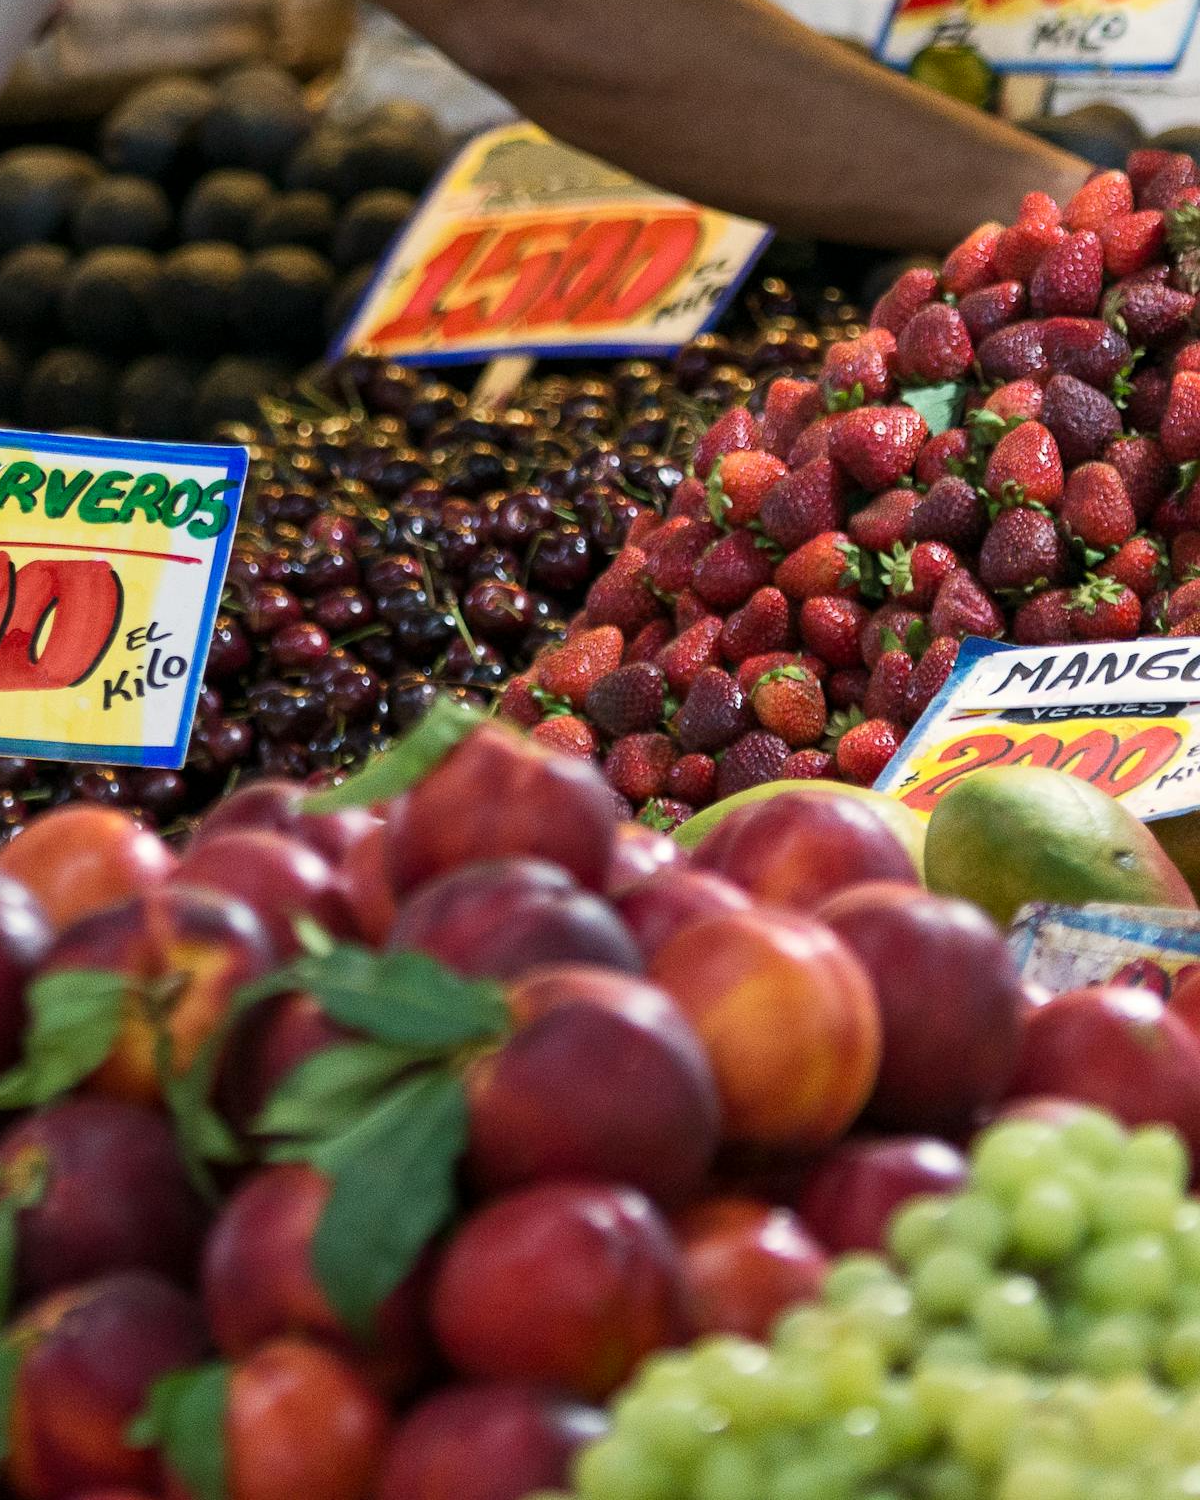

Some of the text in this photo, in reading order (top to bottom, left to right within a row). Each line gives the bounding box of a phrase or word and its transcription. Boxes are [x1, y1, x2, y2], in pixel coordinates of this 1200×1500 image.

[367, 216, 705, 341] 1500
[125, 621, 174, 652] EL
[1031, 702, 1168, 720] VERDES
